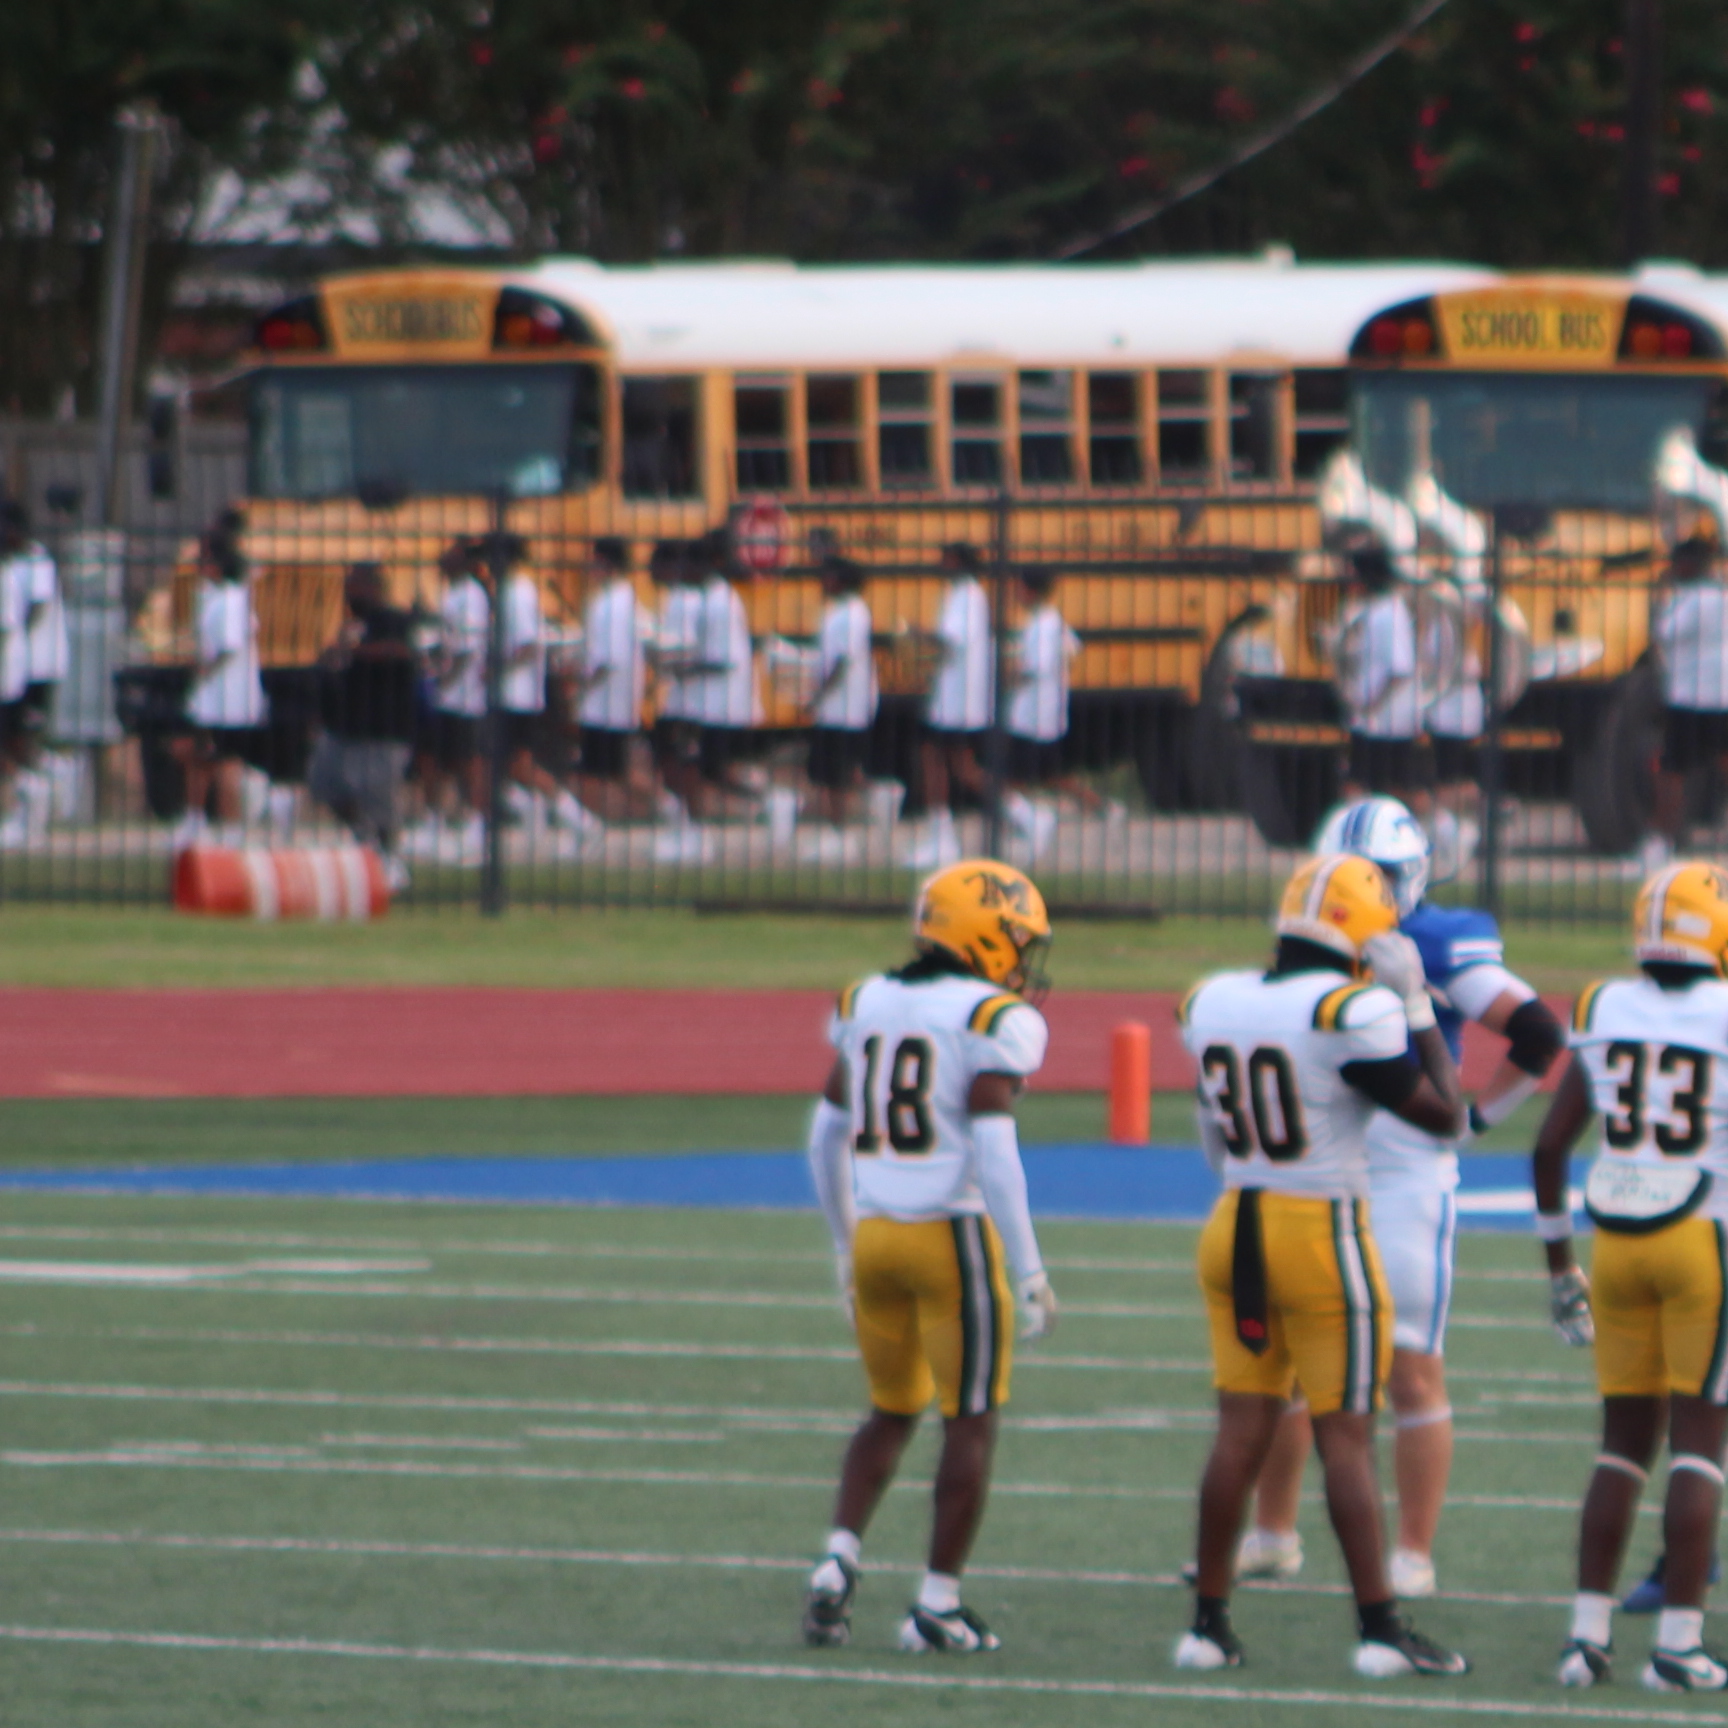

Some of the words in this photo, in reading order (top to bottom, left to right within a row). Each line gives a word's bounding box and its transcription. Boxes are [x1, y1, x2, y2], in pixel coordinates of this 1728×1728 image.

[1461, 311, 1548, 349] SCHOOL
[1559, 313, 1607, 349] BUS
[855, 1033, 937, 1155] 18
[1200, 1045, 1307, 1162] 30
[1604, 1040, 1709, 1156] 33
